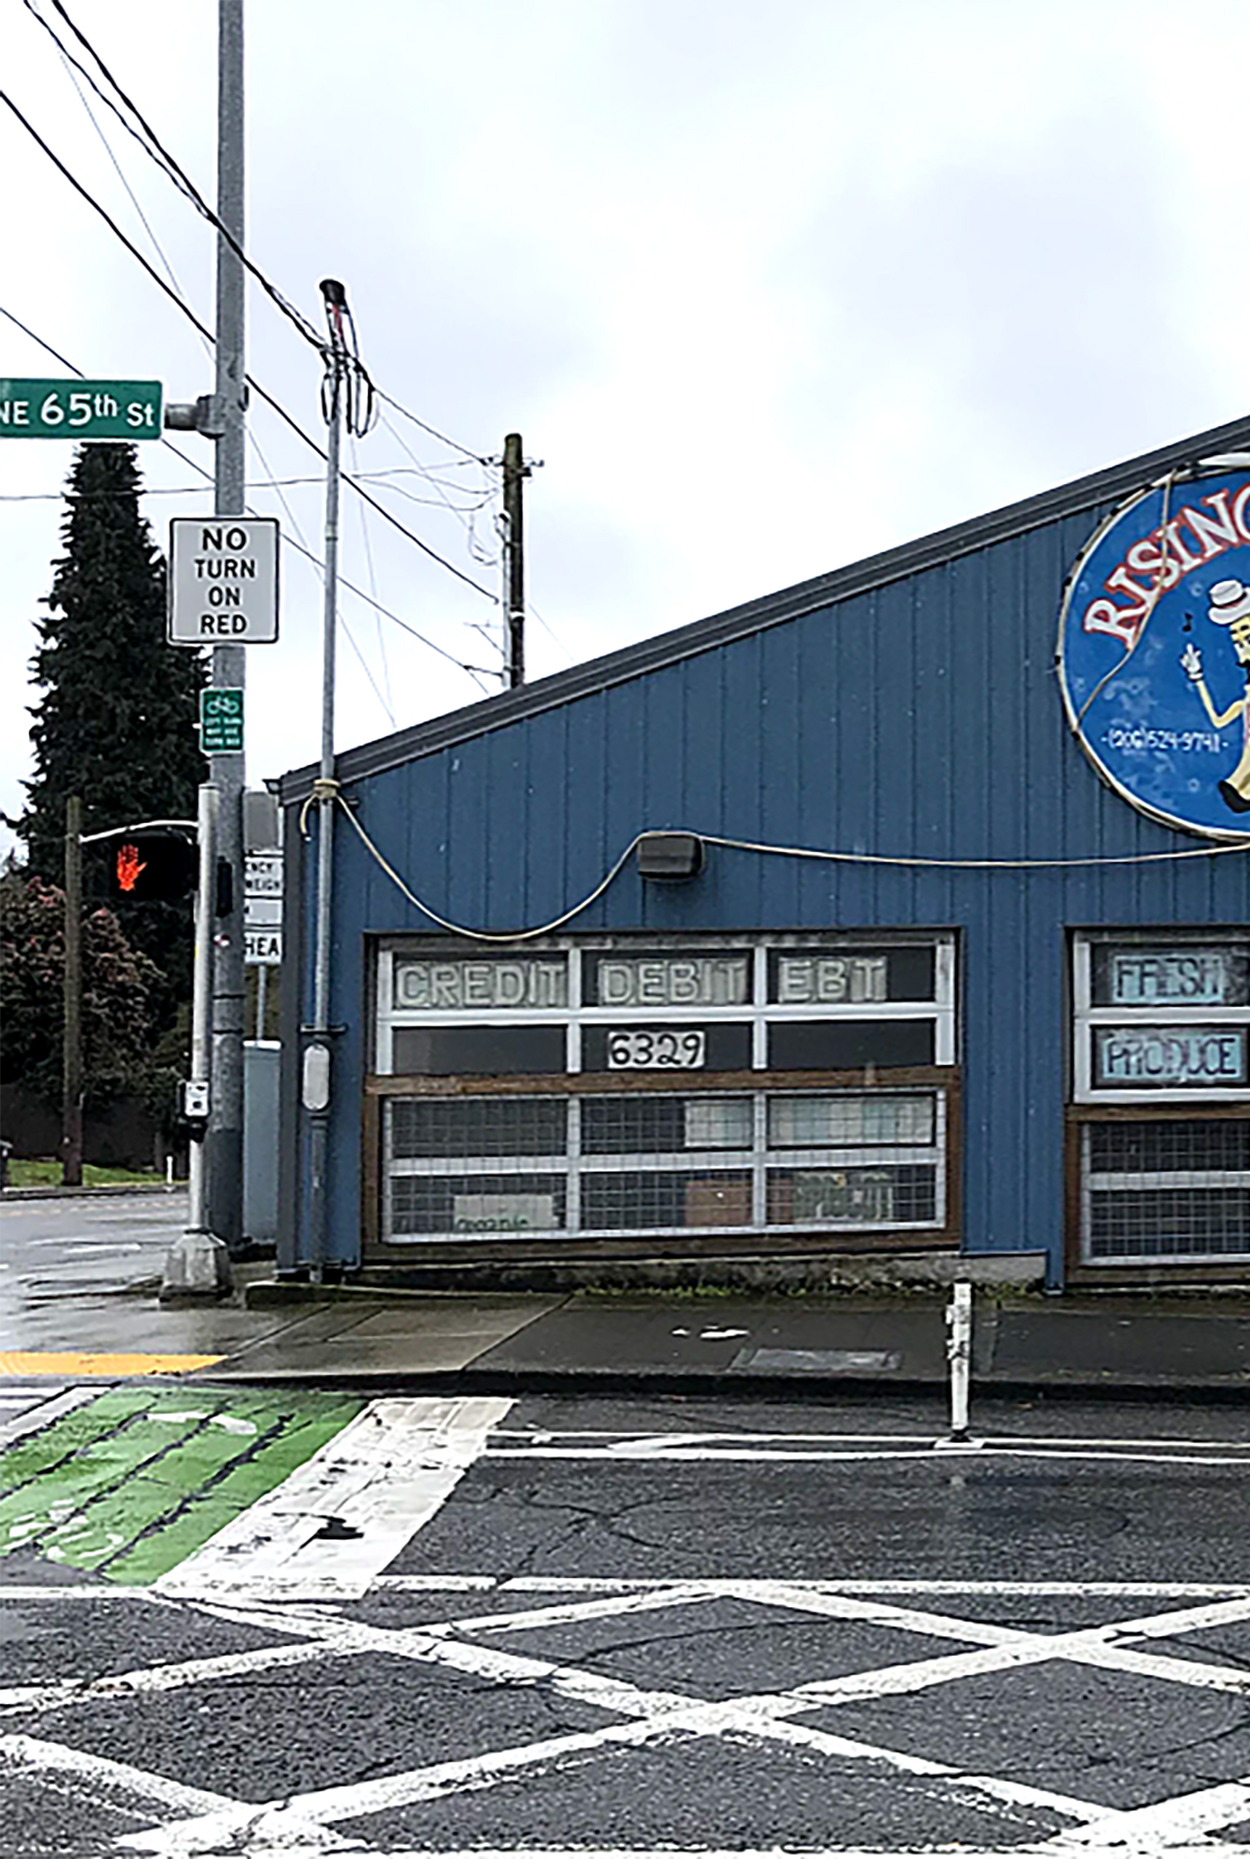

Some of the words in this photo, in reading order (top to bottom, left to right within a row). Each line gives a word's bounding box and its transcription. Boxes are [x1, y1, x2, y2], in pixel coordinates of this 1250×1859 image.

[41, 393, 118, 426] 65th
[127, 402, 155, 427] St
[203, 527, 247, 551] NO
[194, 559, 255, 579] TURN
[208, 586, 240, 607] ON
[200, 614, 247, 634] RED
[396, 963, 566, 1006] CREDIT
[602, 962, 745, 1003] DEBIT
[782, 960, 886, 1000] EBT
[1116, 957, 1221, 998] FRESH
[611, 1034, 701, 1065] 6329
[1107, 1037, 1237, 1076] PRODUCE
